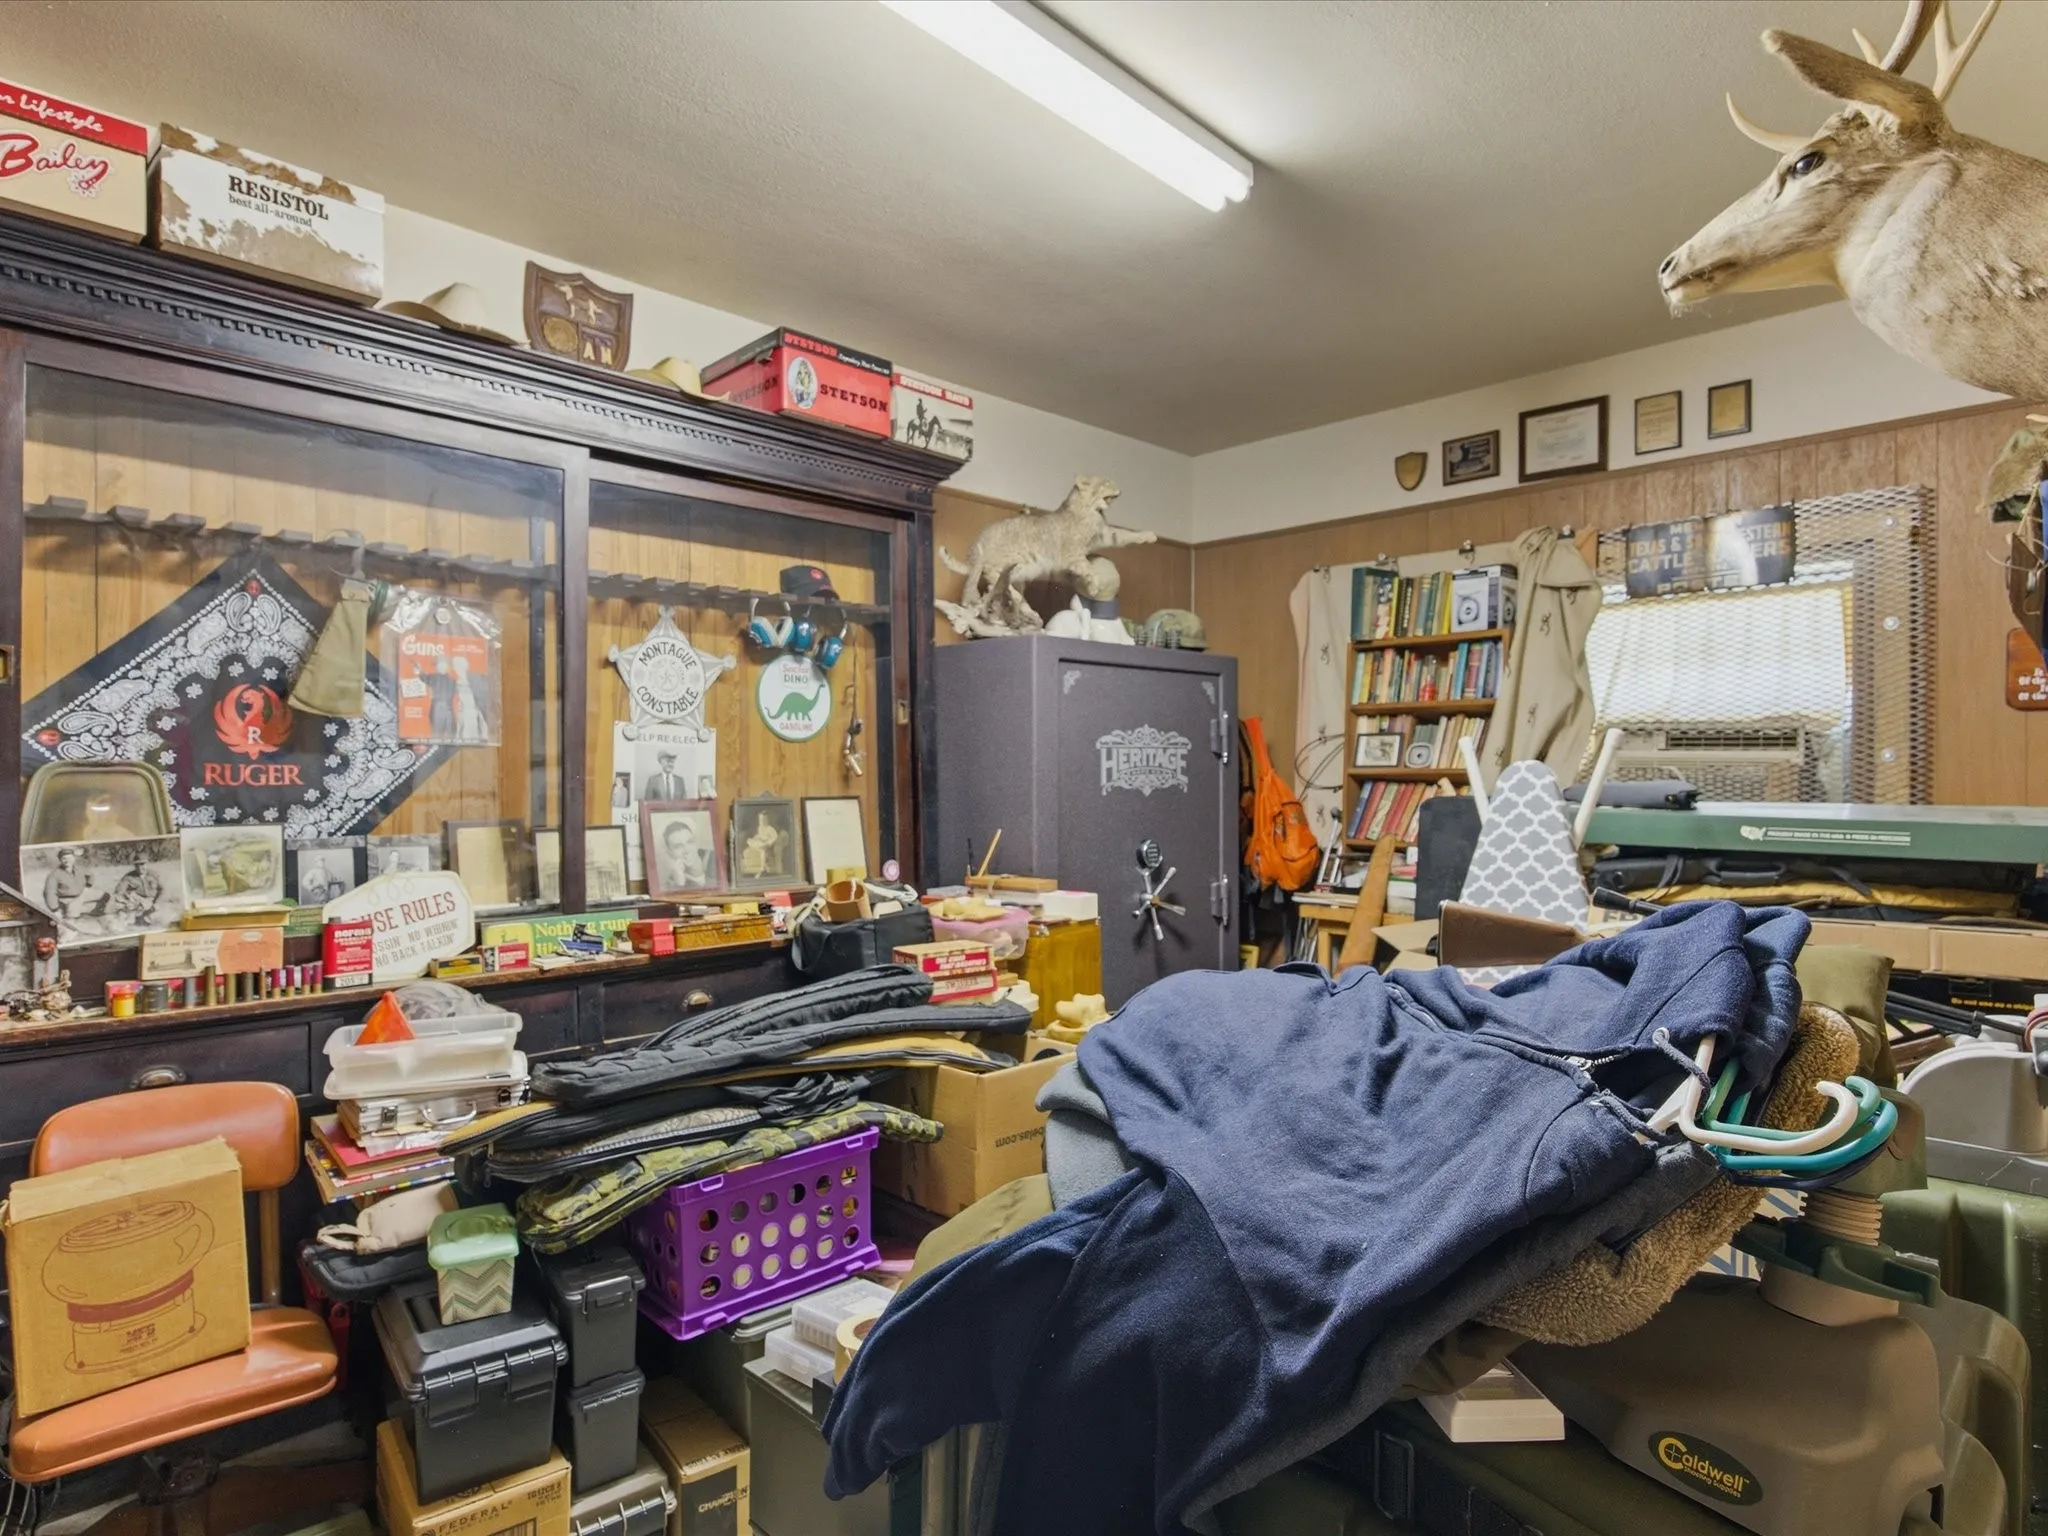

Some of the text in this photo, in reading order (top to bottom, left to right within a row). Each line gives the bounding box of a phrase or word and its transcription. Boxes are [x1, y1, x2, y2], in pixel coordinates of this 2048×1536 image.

[0, 133, 109, 190] Bailey
[228, 174, 329, 221] RESISTOL
[820, 382, 889, 412] STETSON
[638, 641, 698, 670] MONTAGUE
[783, 674, 808, 684] DINO
[636, 685, 700, 716] CONSTABLE
[247, 726, 264, 745] R
[203, 763, 305, 787] RUGER
[1100, 748, 1189, 787] HERITAGE
[400, 891, 456, 926] RULES
[1658, 1437, 1743, 1492] Caldwell
[438, 1503, 508, 1533] FEDERAL
